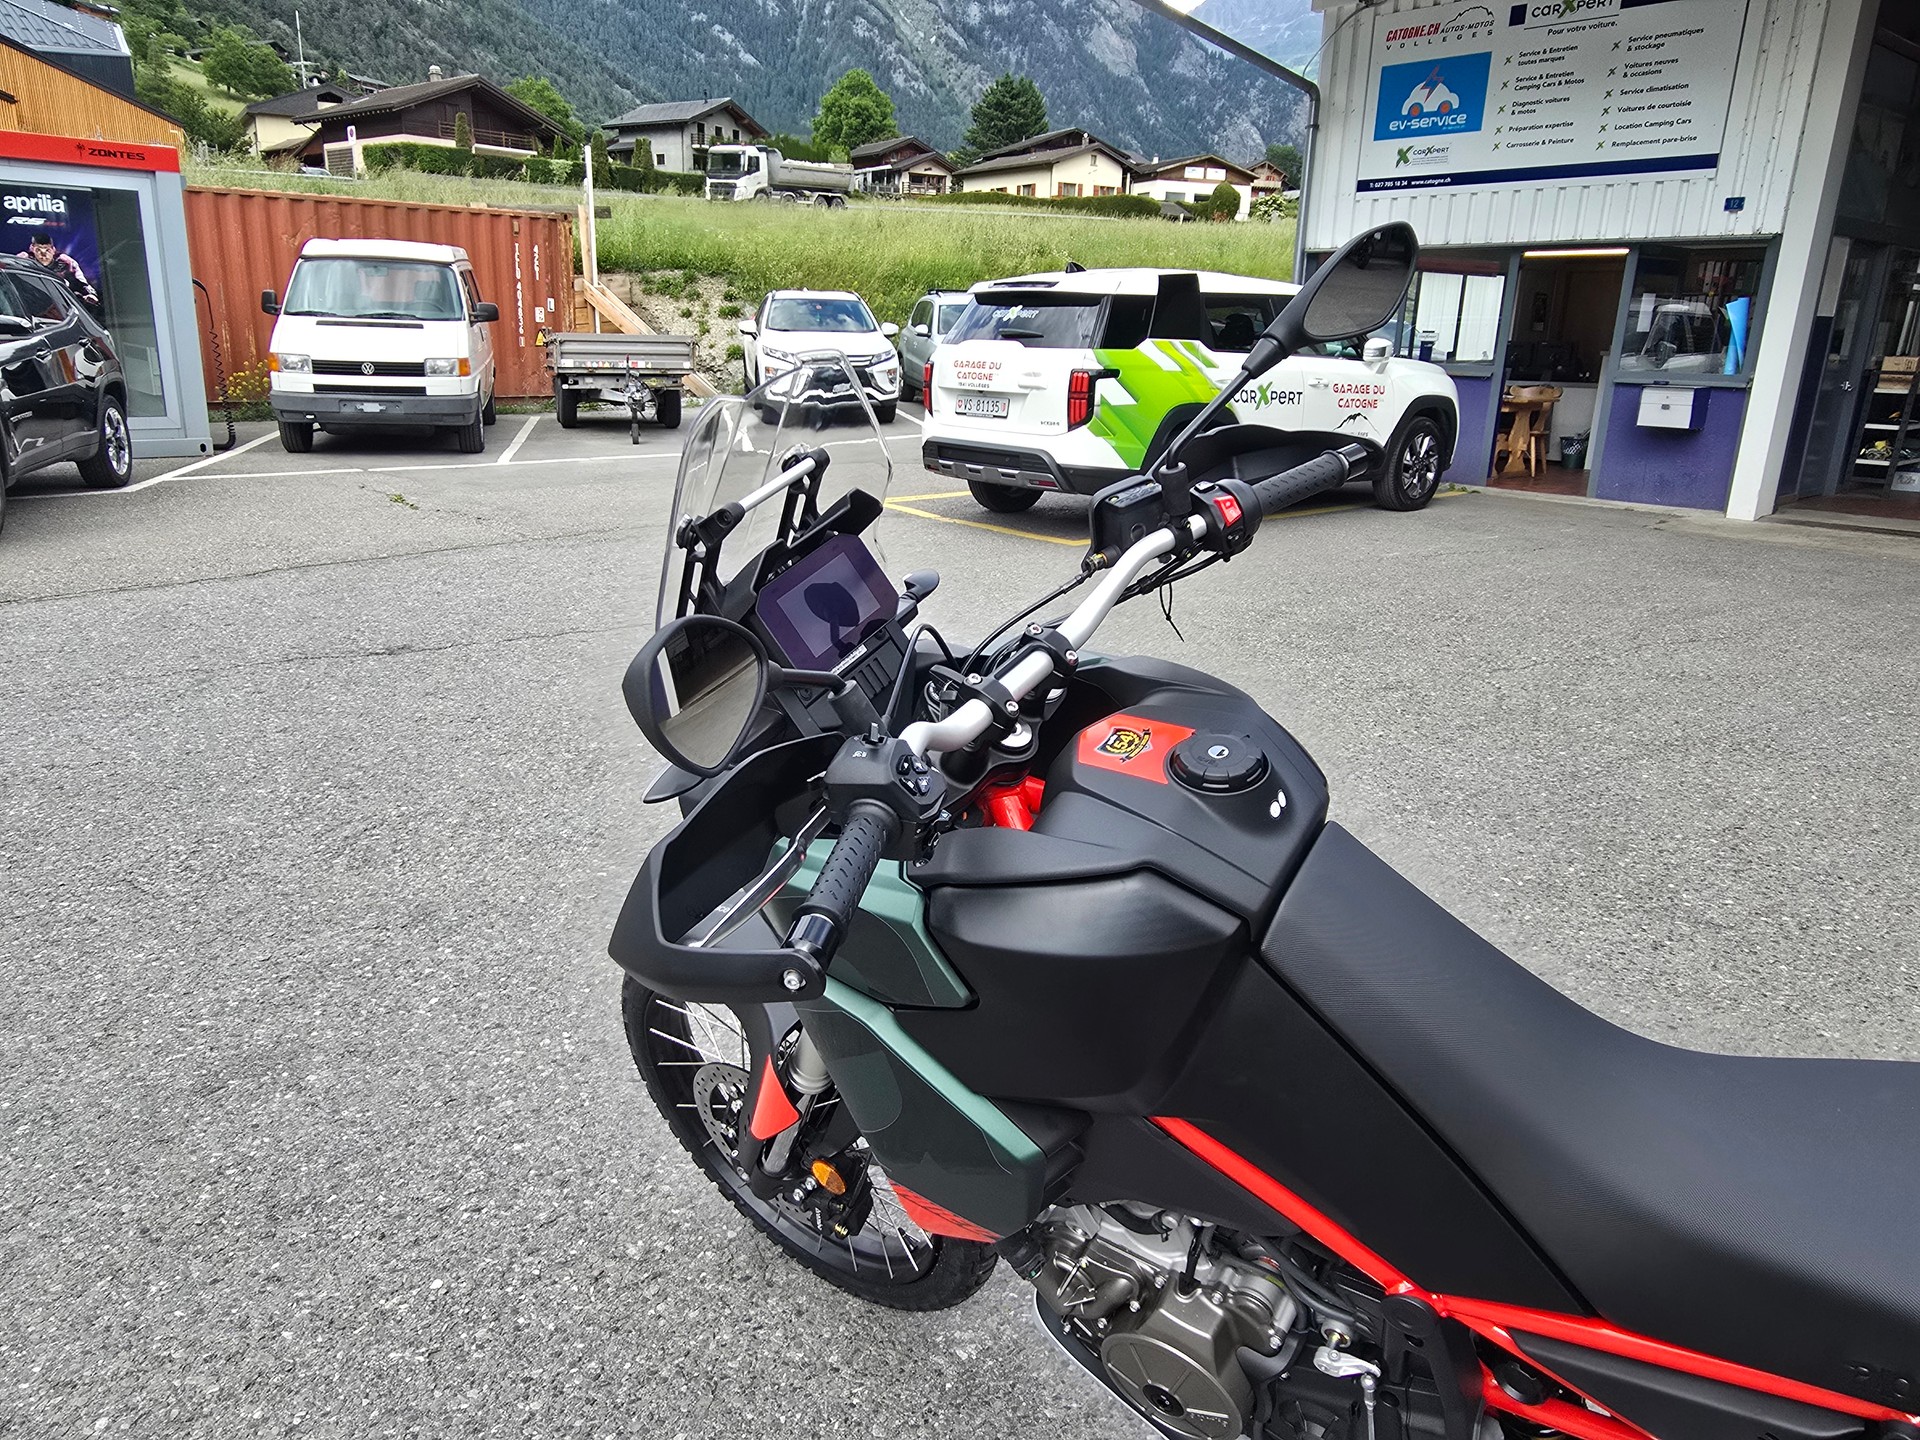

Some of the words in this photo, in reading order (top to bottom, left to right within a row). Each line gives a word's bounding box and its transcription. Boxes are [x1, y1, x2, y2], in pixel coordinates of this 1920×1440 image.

[1589, 21, 1618, 30] voiture.
[1386, 22, 1441, 42] CATOGNE.CH
[1440, 20, 1495, 34] AUTOS-MOTOS
[1654, 28, 1704, 40] pneumatiques
[1519, 50, 1540, 58] Service
[1549, 45, 1578, 54] Entretien
[1634, 42, 1665, 51] stockage
[1539, 55, 1565, 64] marques
[1515, 75, 1537, 83] Service
[1514, 82, 1540, 91] Camping
[1646, 83, 1689, 93] climatisation
[1512, 99, 1544, 108] Diagnostic
[1658, 100, 1692, 109] courtoisie
[1389, 114, 1467, 131] ev-service
[1509, 124, 1543, 133] Préparation
[1545, 121, 1574, 129] expertise
[1644, 120, 1674, 128] Camping
[1612, 139, 1660, 148] Remplacement
[1662, 136, 1697, 144] pare-brise
[88, 148, 145, 161] ZONTES
[1411, 177, 1451, 185] www.catogne.ch
[4, 193, 65, 213] aprilia
[954, 360, 986, 370] GARAGE
[989, 362, 1002, 370] DU
[957, 371, 993, 381] CATOGNE
[1333, 383, 1370, 394] GARAGE
[1373, 385, 1385, 395] DU
[1338, 398, 1378, 408] CATOGNE
